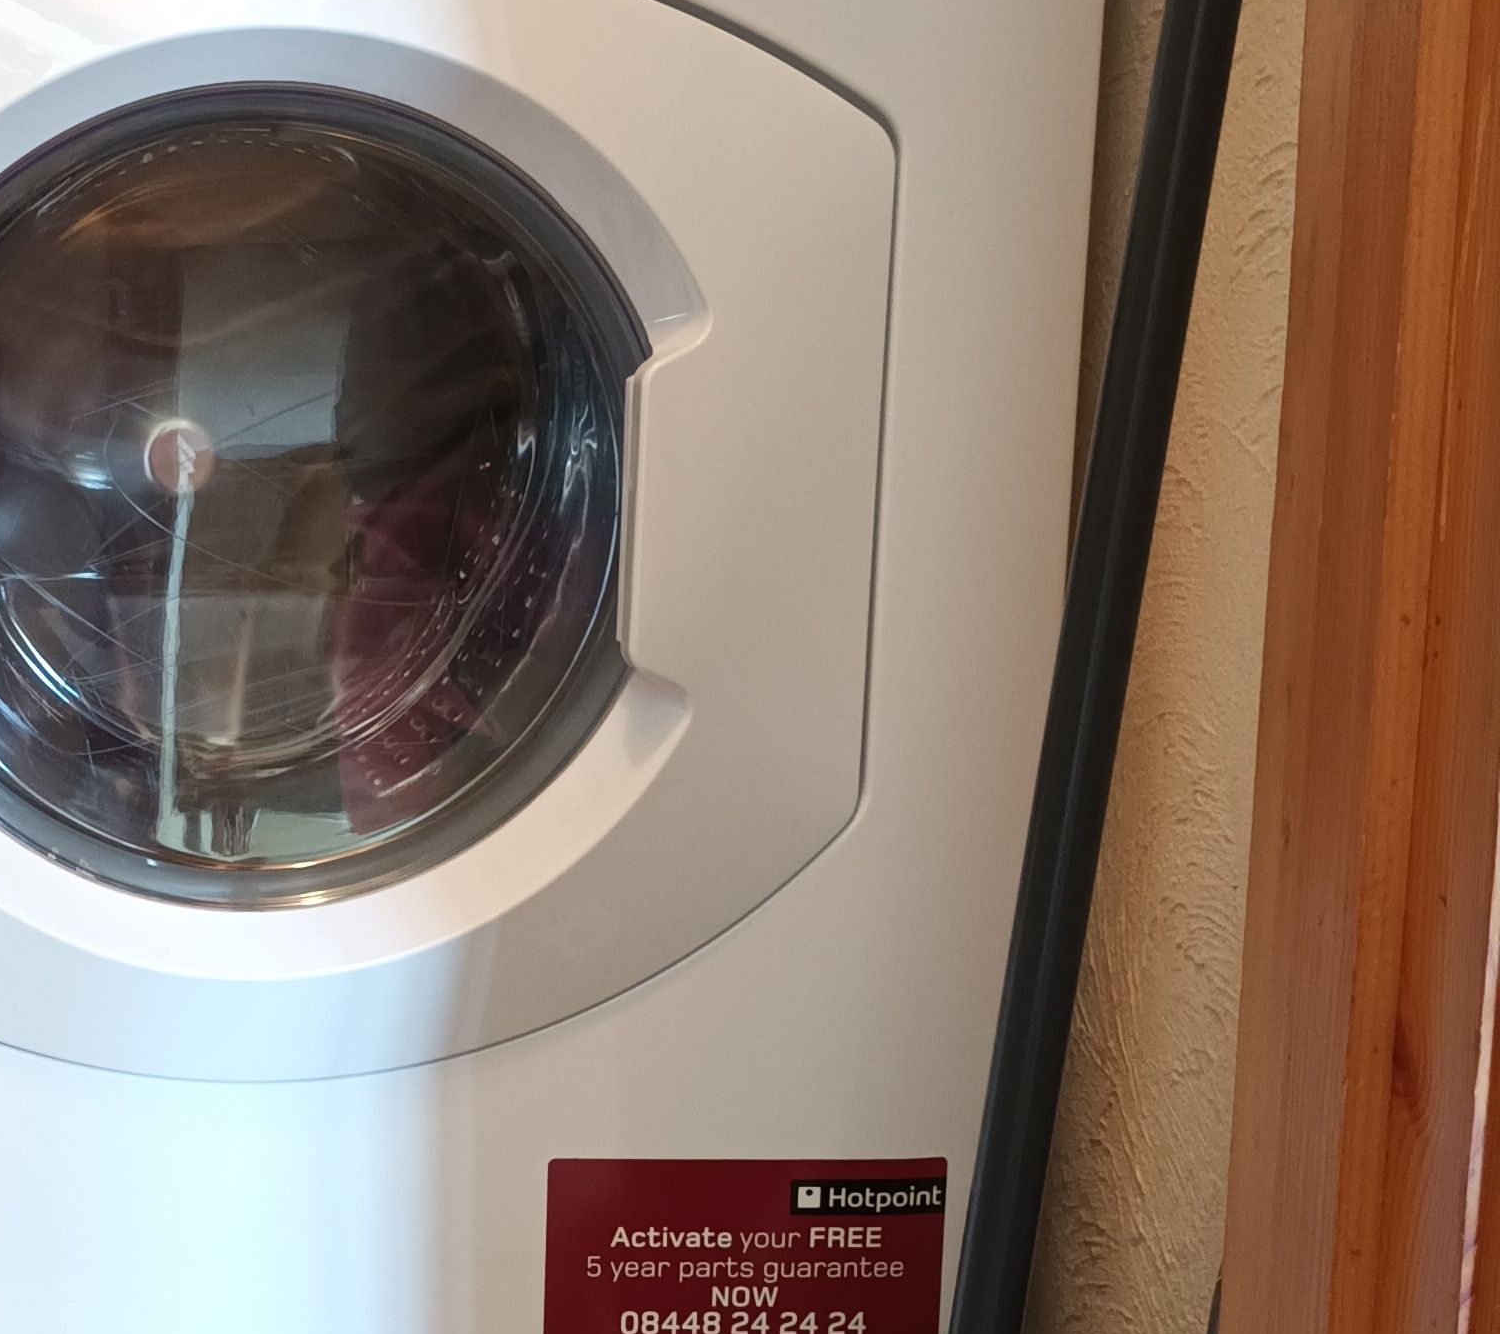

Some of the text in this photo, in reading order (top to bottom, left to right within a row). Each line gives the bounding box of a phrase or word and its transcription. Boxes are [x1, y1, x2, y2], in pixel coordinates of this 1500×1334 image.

[828, 1185, 942, 1213] Hotpoint
[610, 1226, 883, 1254] Activate your FREE
[586, 1255, 904, 1284] 5 year parts guarantee
[711, 1285, 779, 1308] NOW
